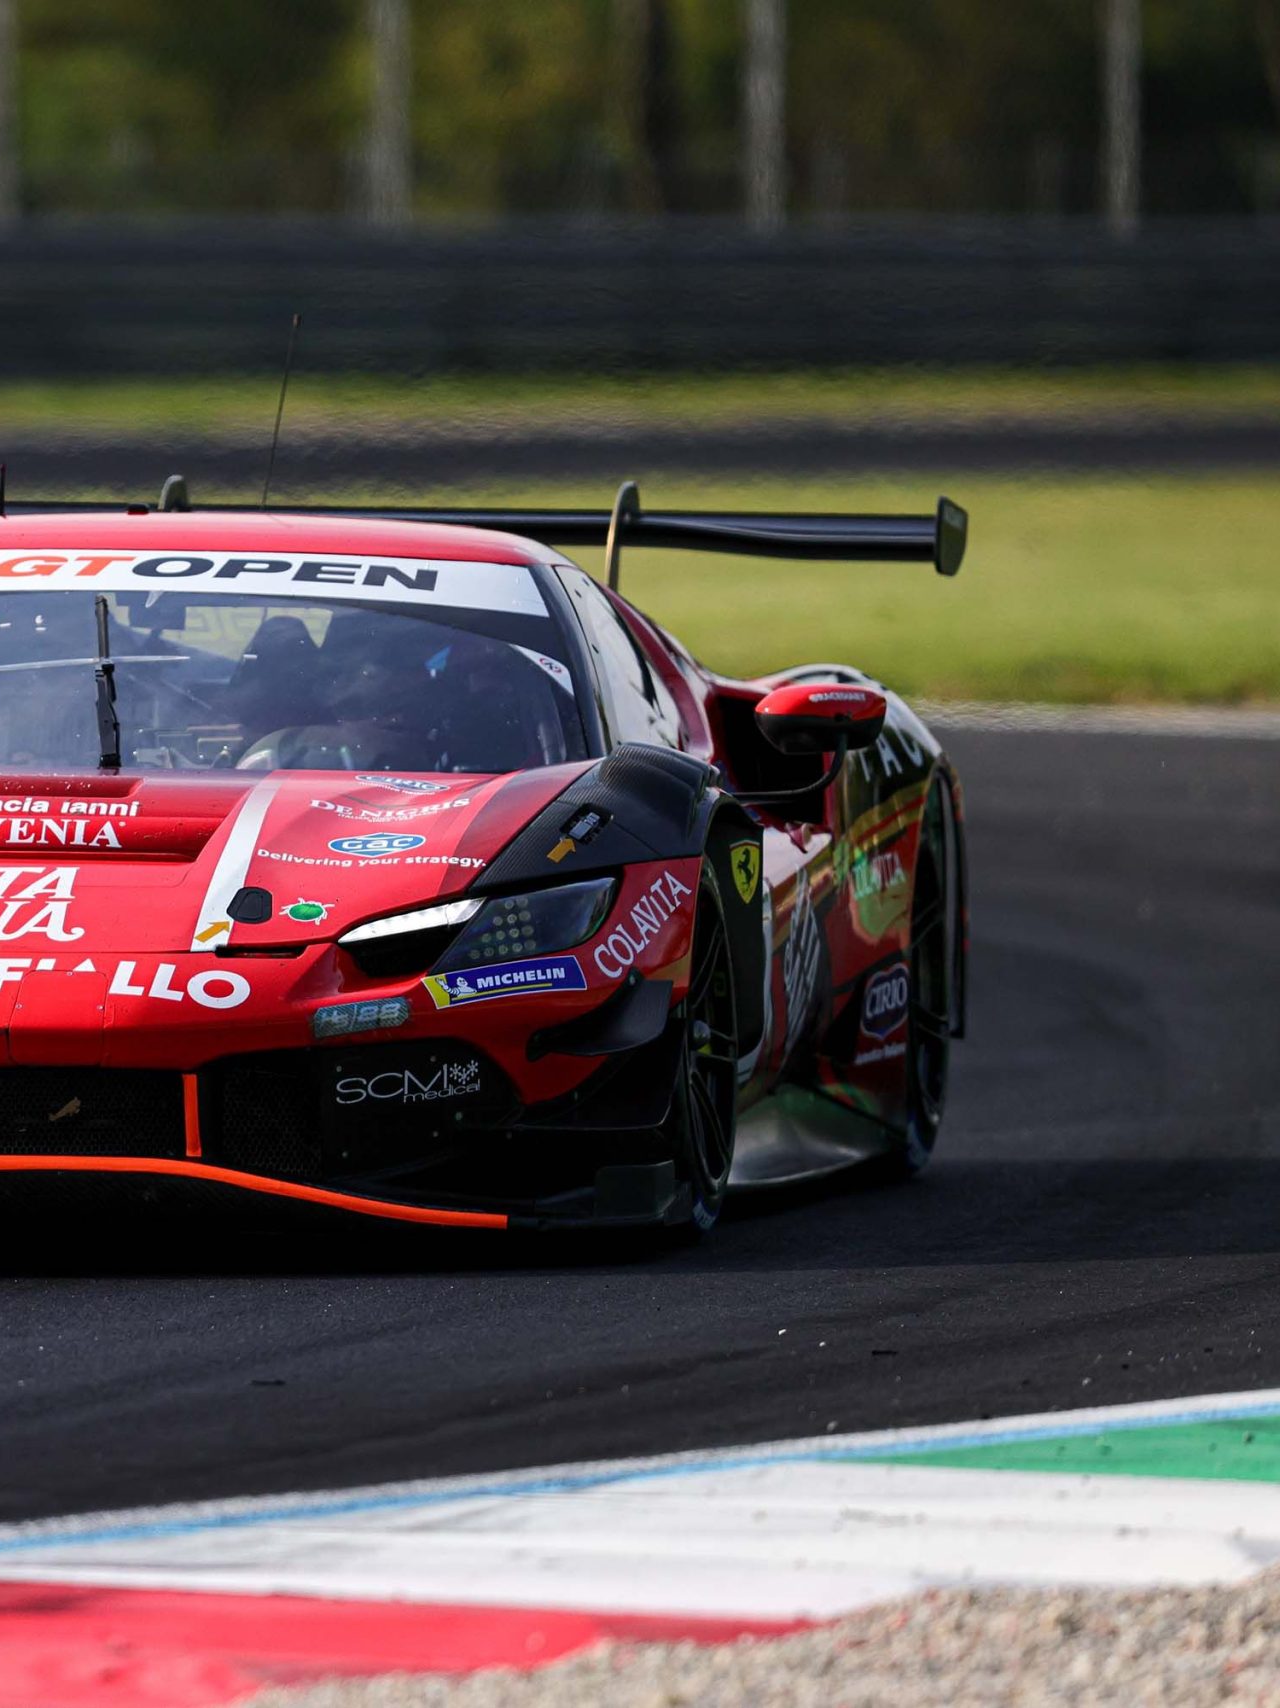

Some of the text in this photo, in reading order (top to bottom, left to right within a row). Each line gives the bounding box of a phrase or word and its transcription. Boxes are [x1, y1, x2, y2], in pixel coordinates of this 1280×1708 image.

[61, 801, 140, 817] ianni
[310, 800, 353, 816] DE
[360, 799, 470, 818] NIGRIS
[257, 849, 486, 868] Delivering your strategy.
[593, 870, 692, 978] COLAVITA
[477, 967, 565, 989] MICHELIN
[866, 977, 908, 1019] CIRIO
[336, 1063, 448, 1104] SCM
[403, 1079, 481, 1104] medical
